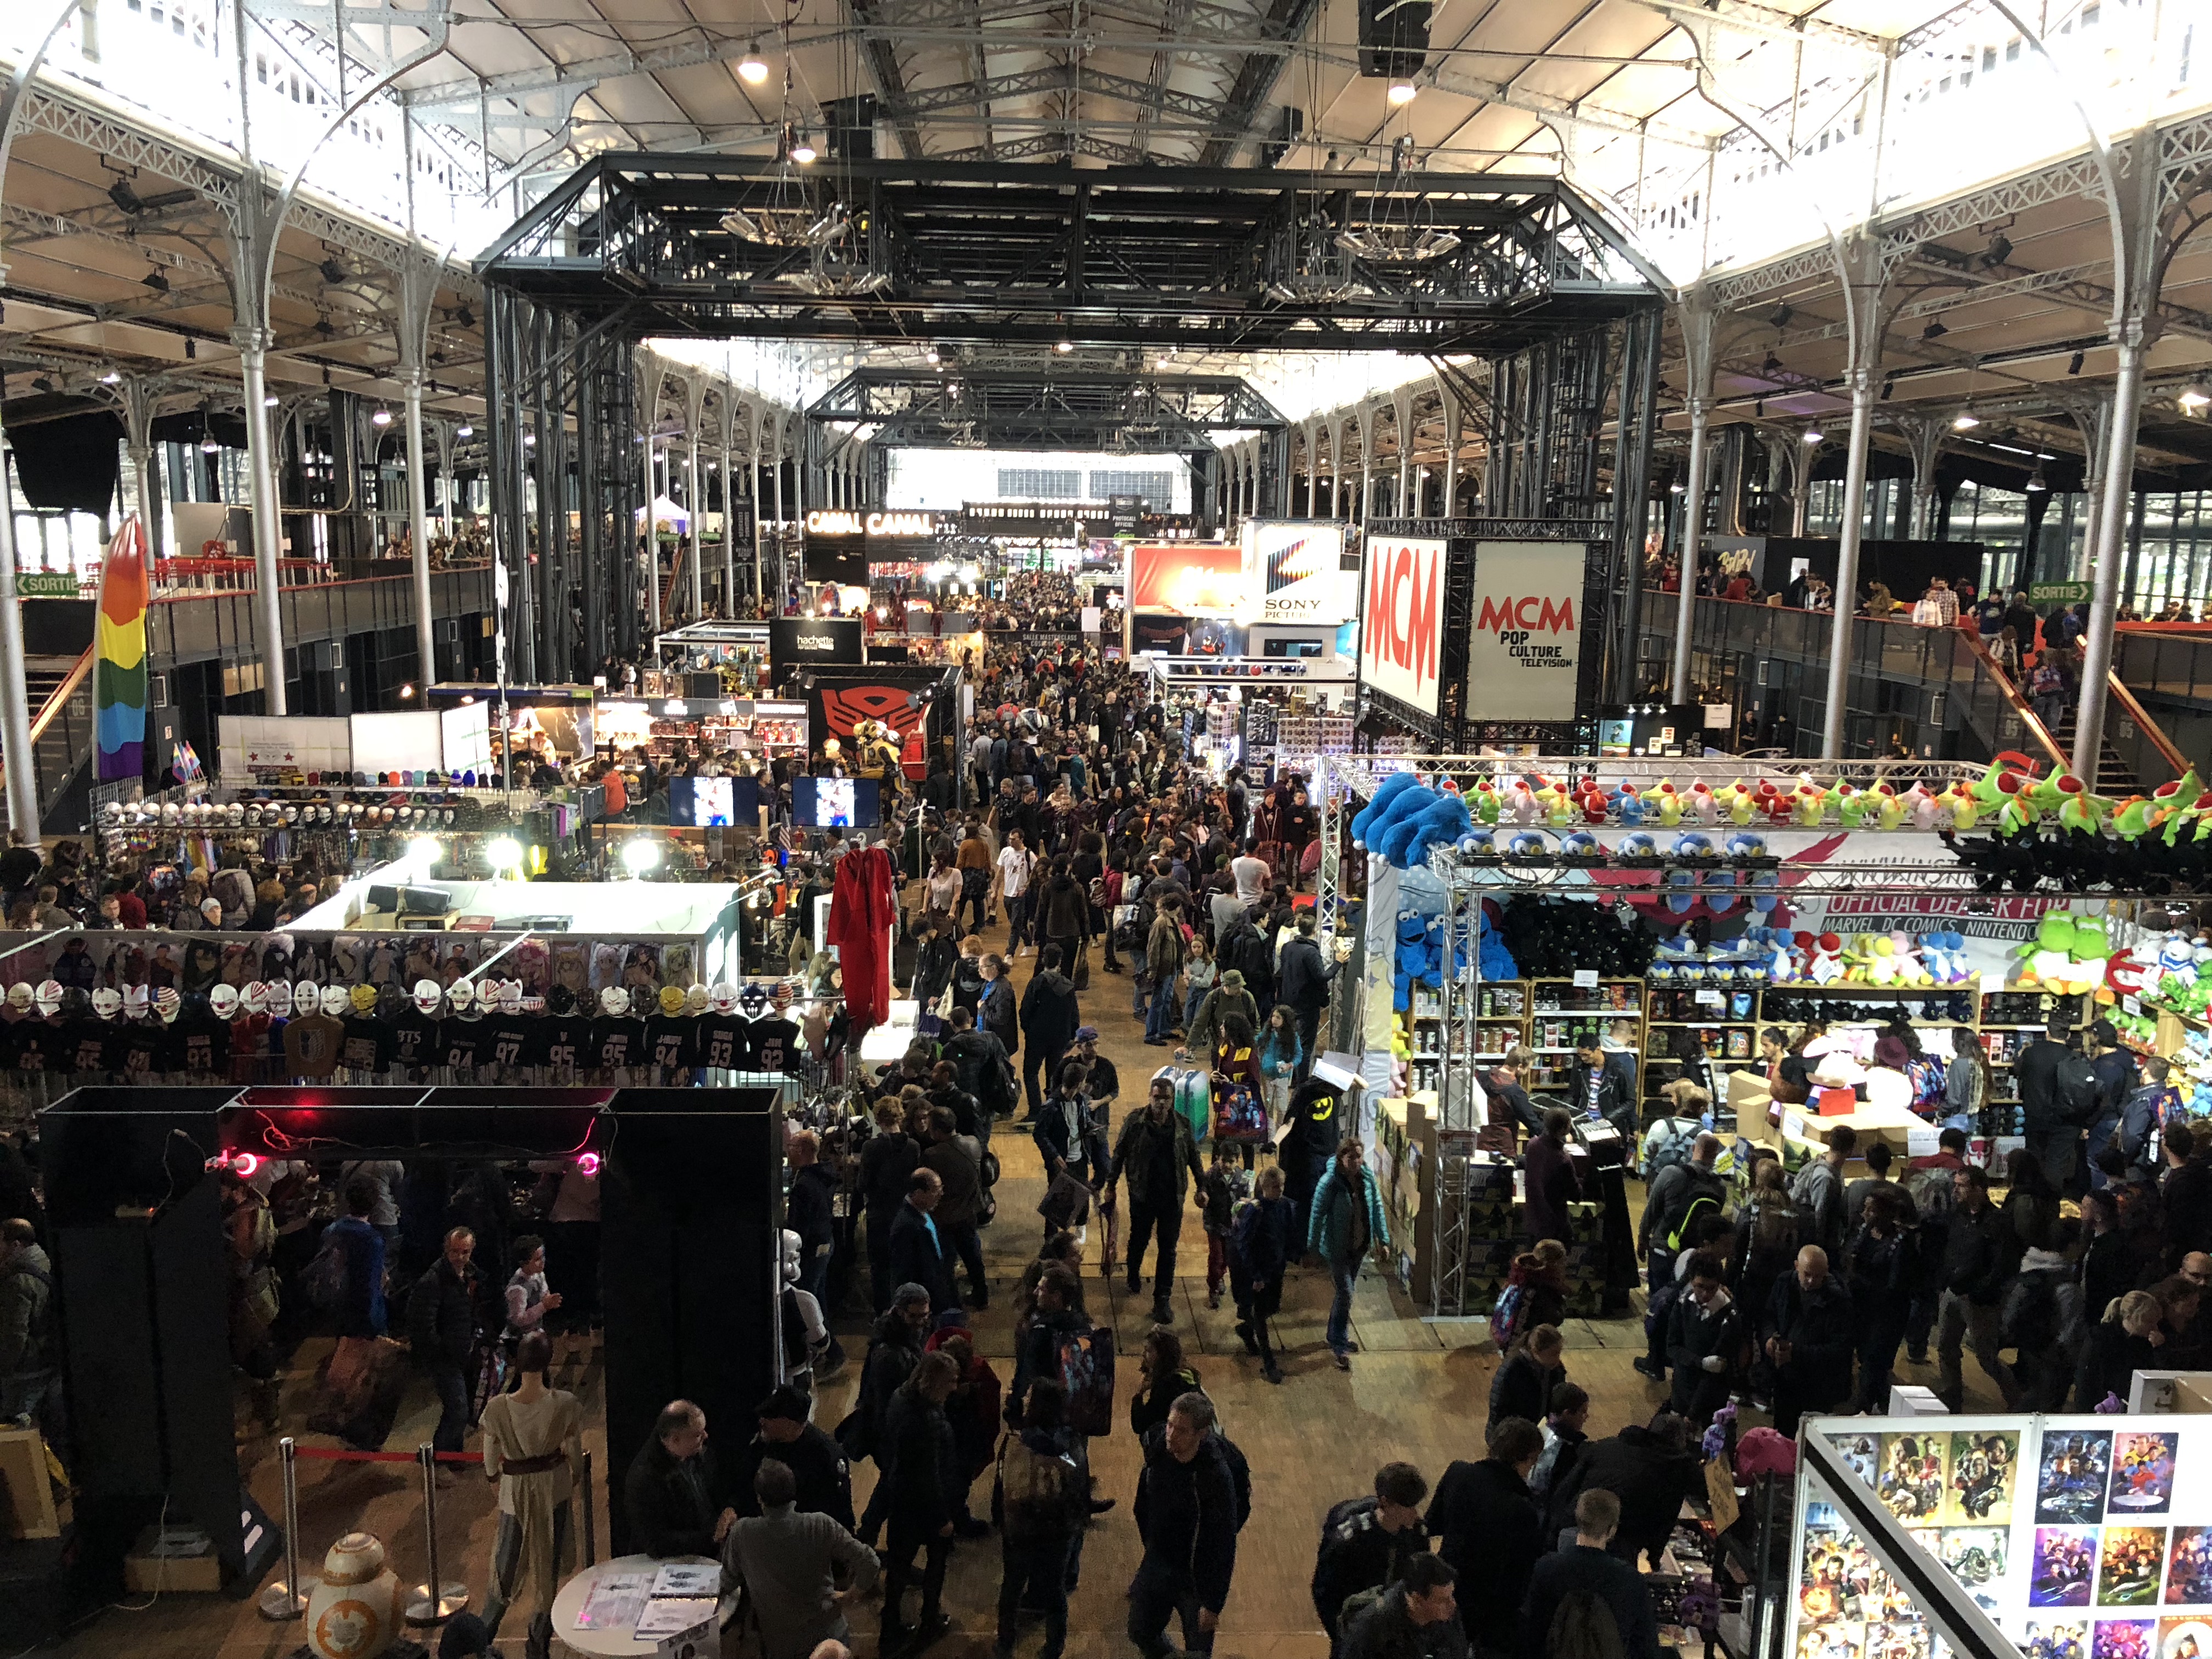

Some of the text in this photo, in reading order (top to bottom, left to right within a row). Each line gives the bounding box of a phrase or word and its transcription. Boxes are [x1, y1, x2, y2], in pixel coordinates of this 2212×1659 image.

[808, 511, 864, 533] CANAL
[867, 513, 934, 535] CANAL
[29, 578, 79, 591] SORTIE
[2033, 586, 2078, 599] SORTIE
[1265, 599, 1321, 610] SONY
[1365, 545, 1437, 696] MCM
[1477, 596, 1575, 636] MCM
[797, 635, 834, 644] hachette
[1500, 631, 1529, 645] POP
[1509, 646, 1562, 657] CULTURE
[1521, 659, 1572, 667] TELEVISION
[1830, 896, 1921, 912] OFFICIAL
[1882, 917, 1901, 932] DC
[397, 1030, 421, 1043] BTS
[495, 1042, 521, 1065] 97
[550, 1045, 575, 1068] 95
[602, 1044, 627, 1067] 95
[656, 1045, 678, 1068] 94
[708, 1041, 733, 1068] 93
[760, 1049, 784, 1072] 92
